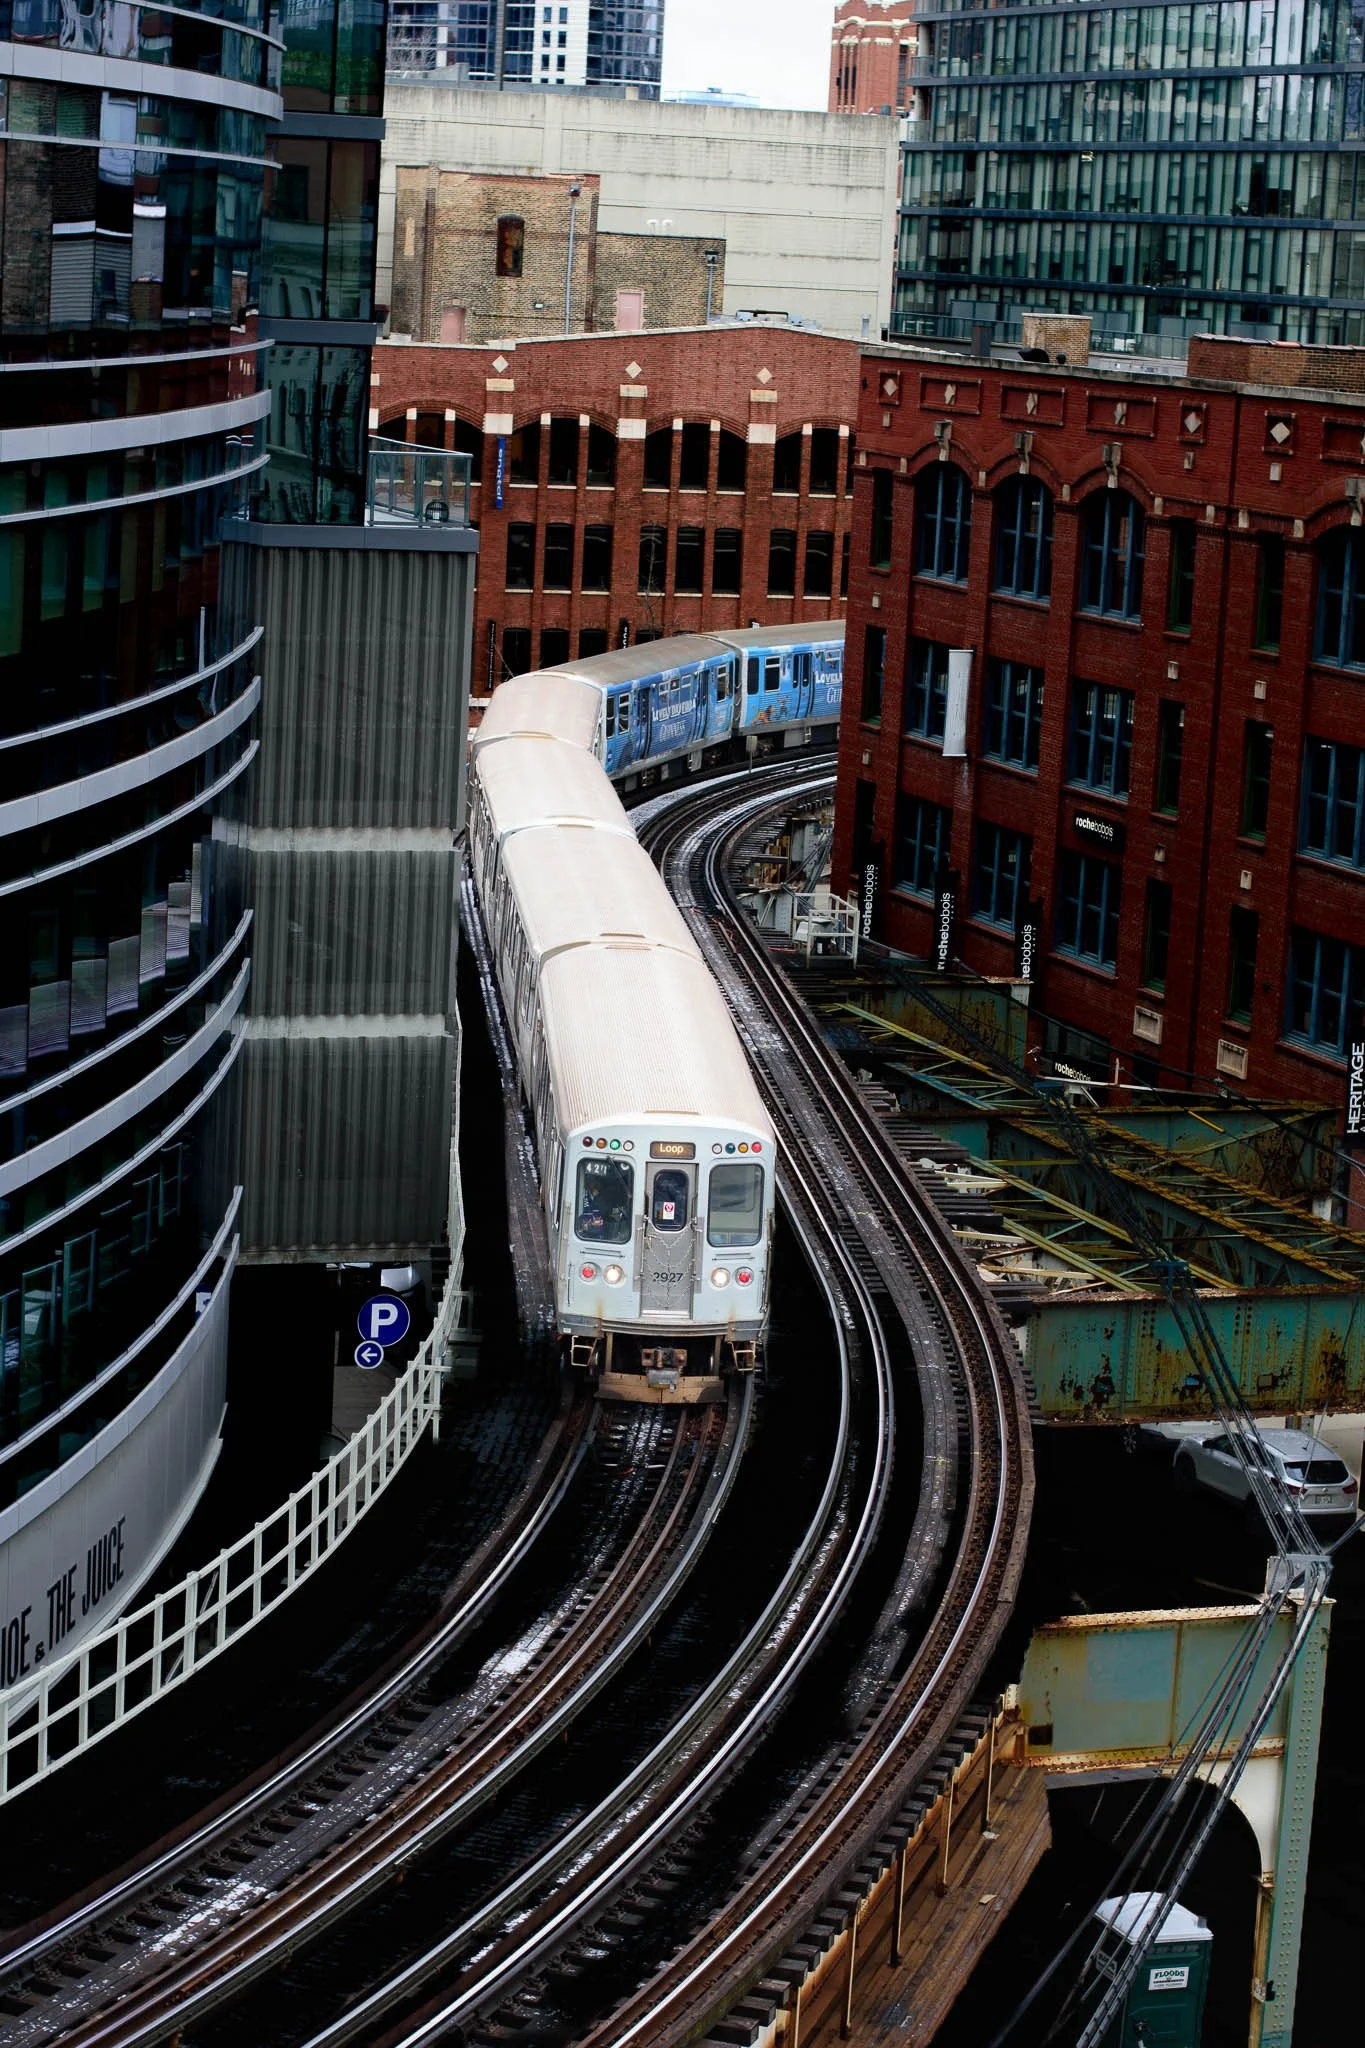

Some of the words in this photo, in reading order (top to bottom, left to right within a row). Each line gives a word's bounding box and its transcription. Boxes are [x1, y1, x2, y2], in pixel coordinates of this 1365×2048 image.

[1075, 817, 1113, 837] rochebobois
[1347, 1042, 1365, 1133] HERITAGE
[660, 1143, 684, 1155] Loop
[653, 1272, 683, 1283] 2927
[370, 1303, 398, 1338] P
[34, 1640, 45, 1664] &
[47, 1563, 77, 1652] THE
[82, 1513, 126, 1617] JUICE
[1154, 1970, 1185, 1979] FLOODS
